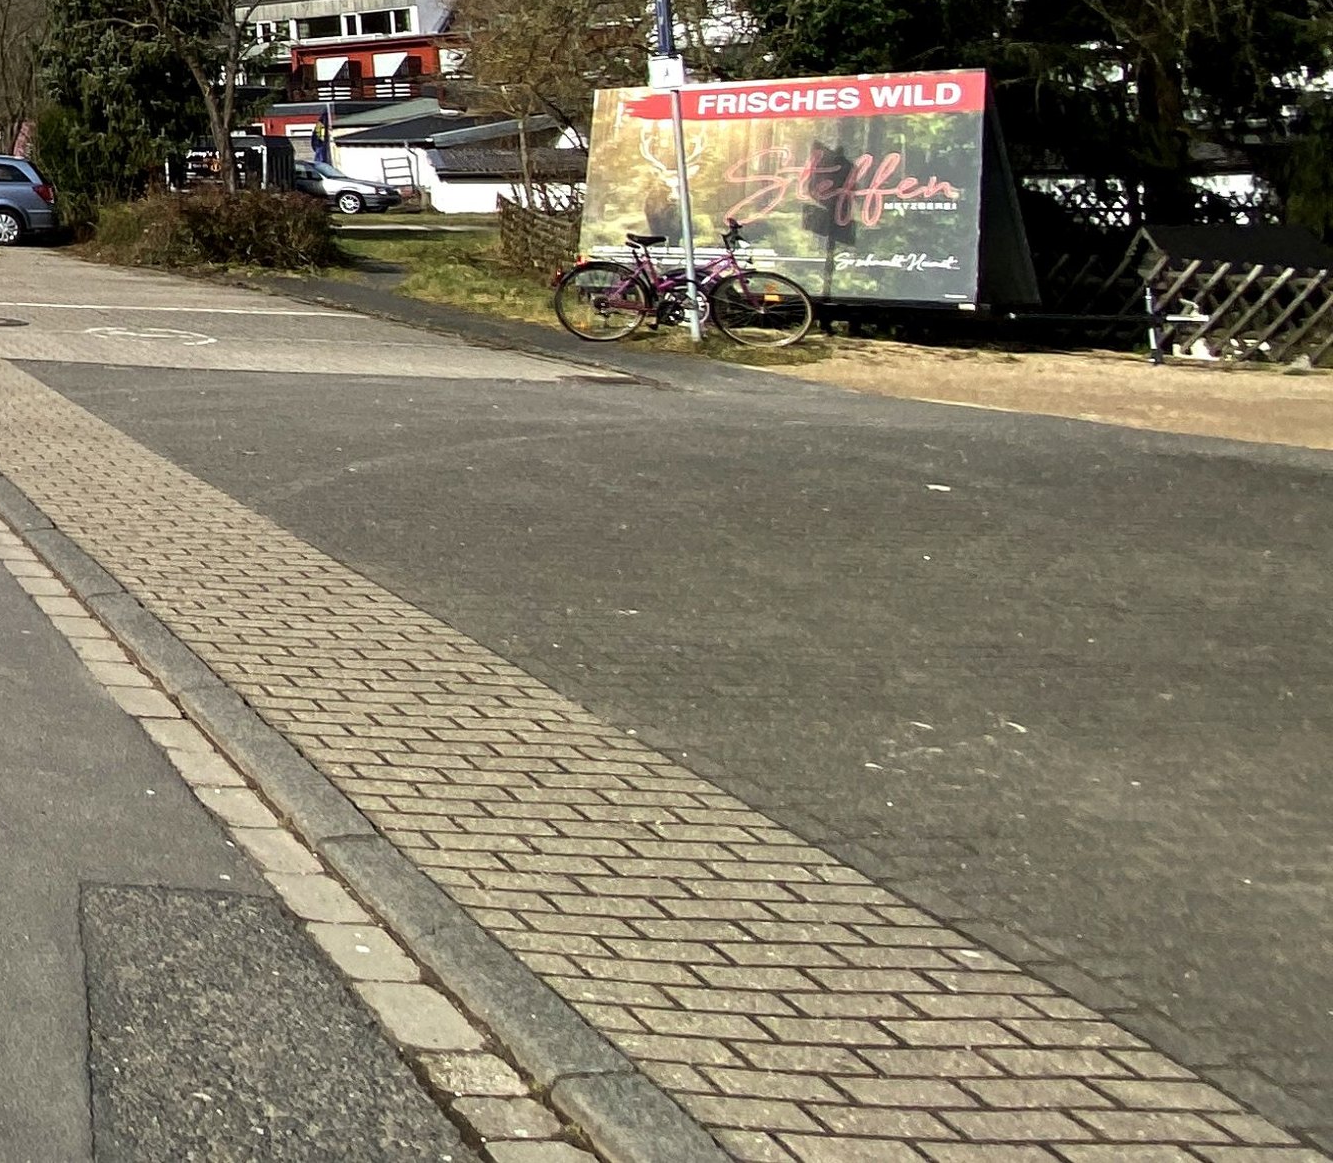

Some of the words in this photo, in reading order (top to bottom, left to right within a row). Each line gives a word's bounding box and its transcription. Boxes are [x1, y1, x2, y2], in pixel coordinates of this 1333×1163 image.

[697, 87, 859, 114] FRISCHES
[870, 82, 961, 107] WILD
[726, 146, 959, 226] Steffen
